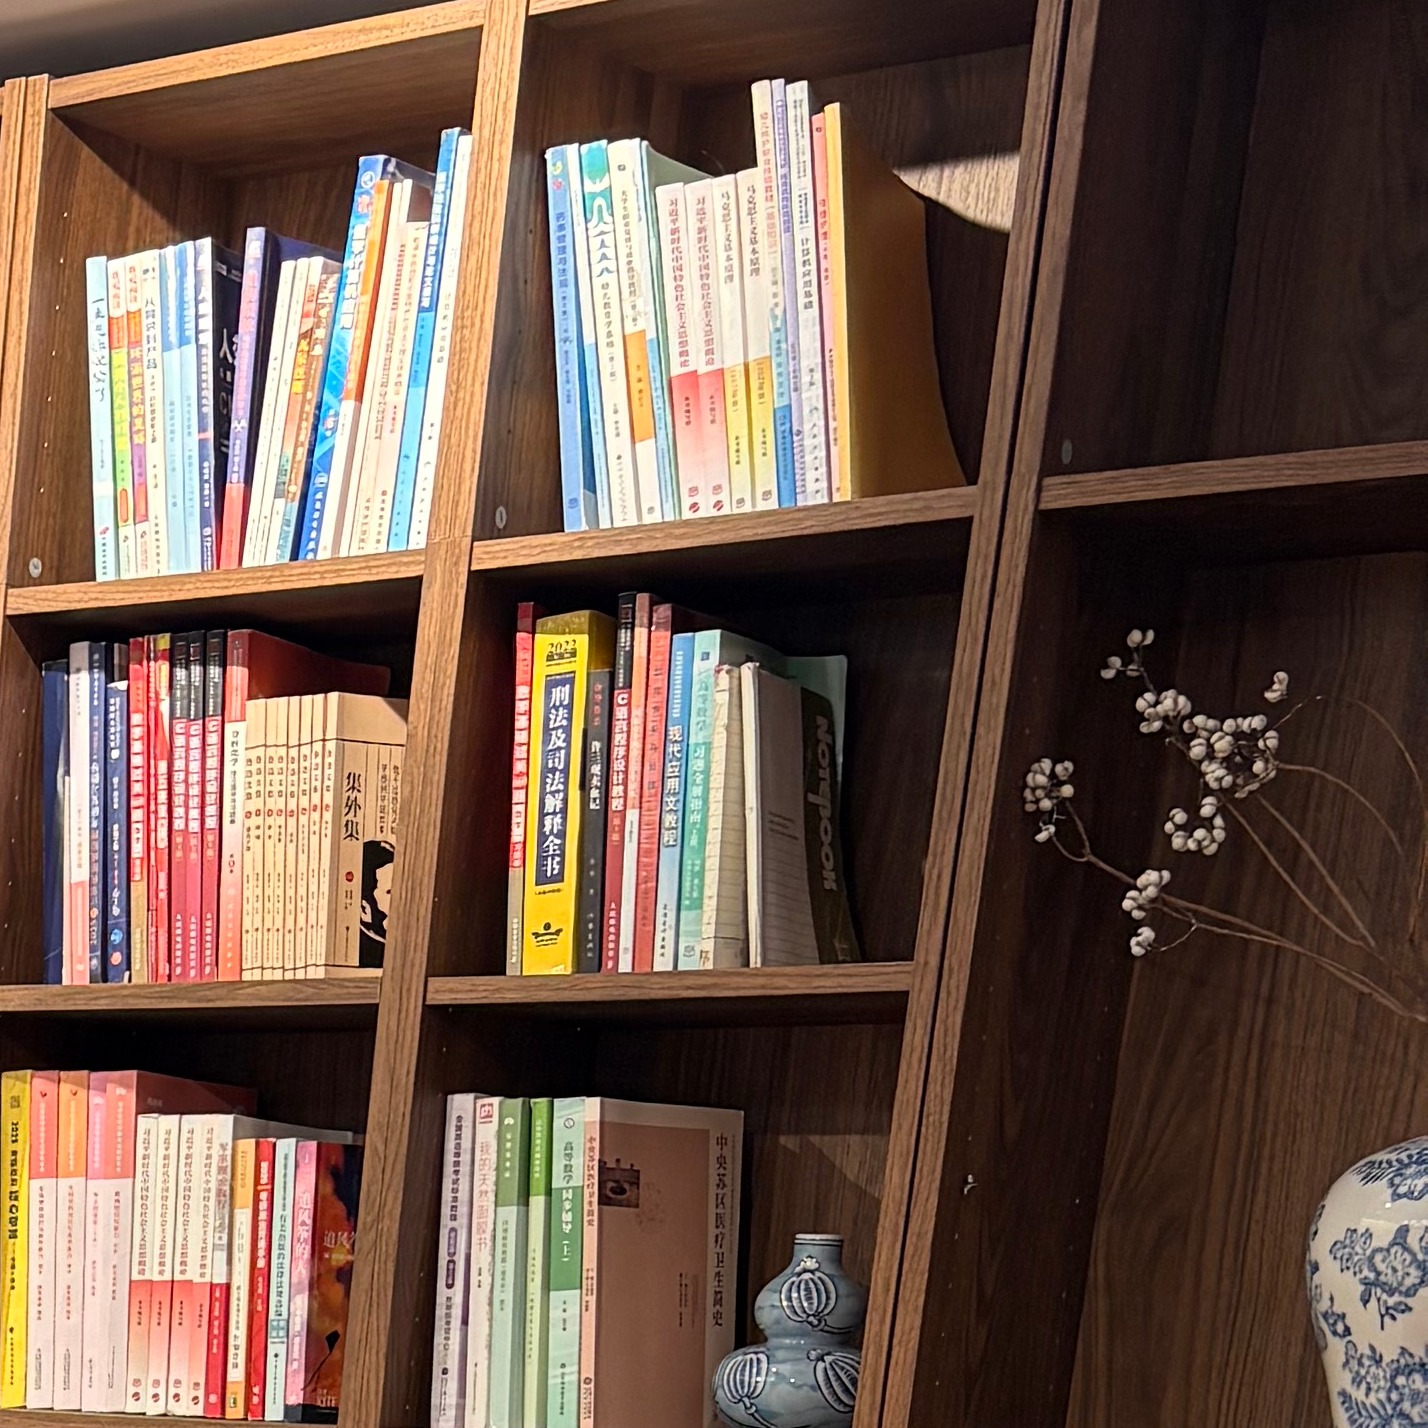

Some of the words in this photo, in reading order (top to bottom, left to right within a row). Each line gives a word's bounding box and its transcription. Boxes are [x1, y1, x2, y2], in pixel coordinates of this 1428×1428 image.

[344, 772, 363, 841] 集外集
[713, 1132, 728, 1327] 中央苏区医疗卫生简史
